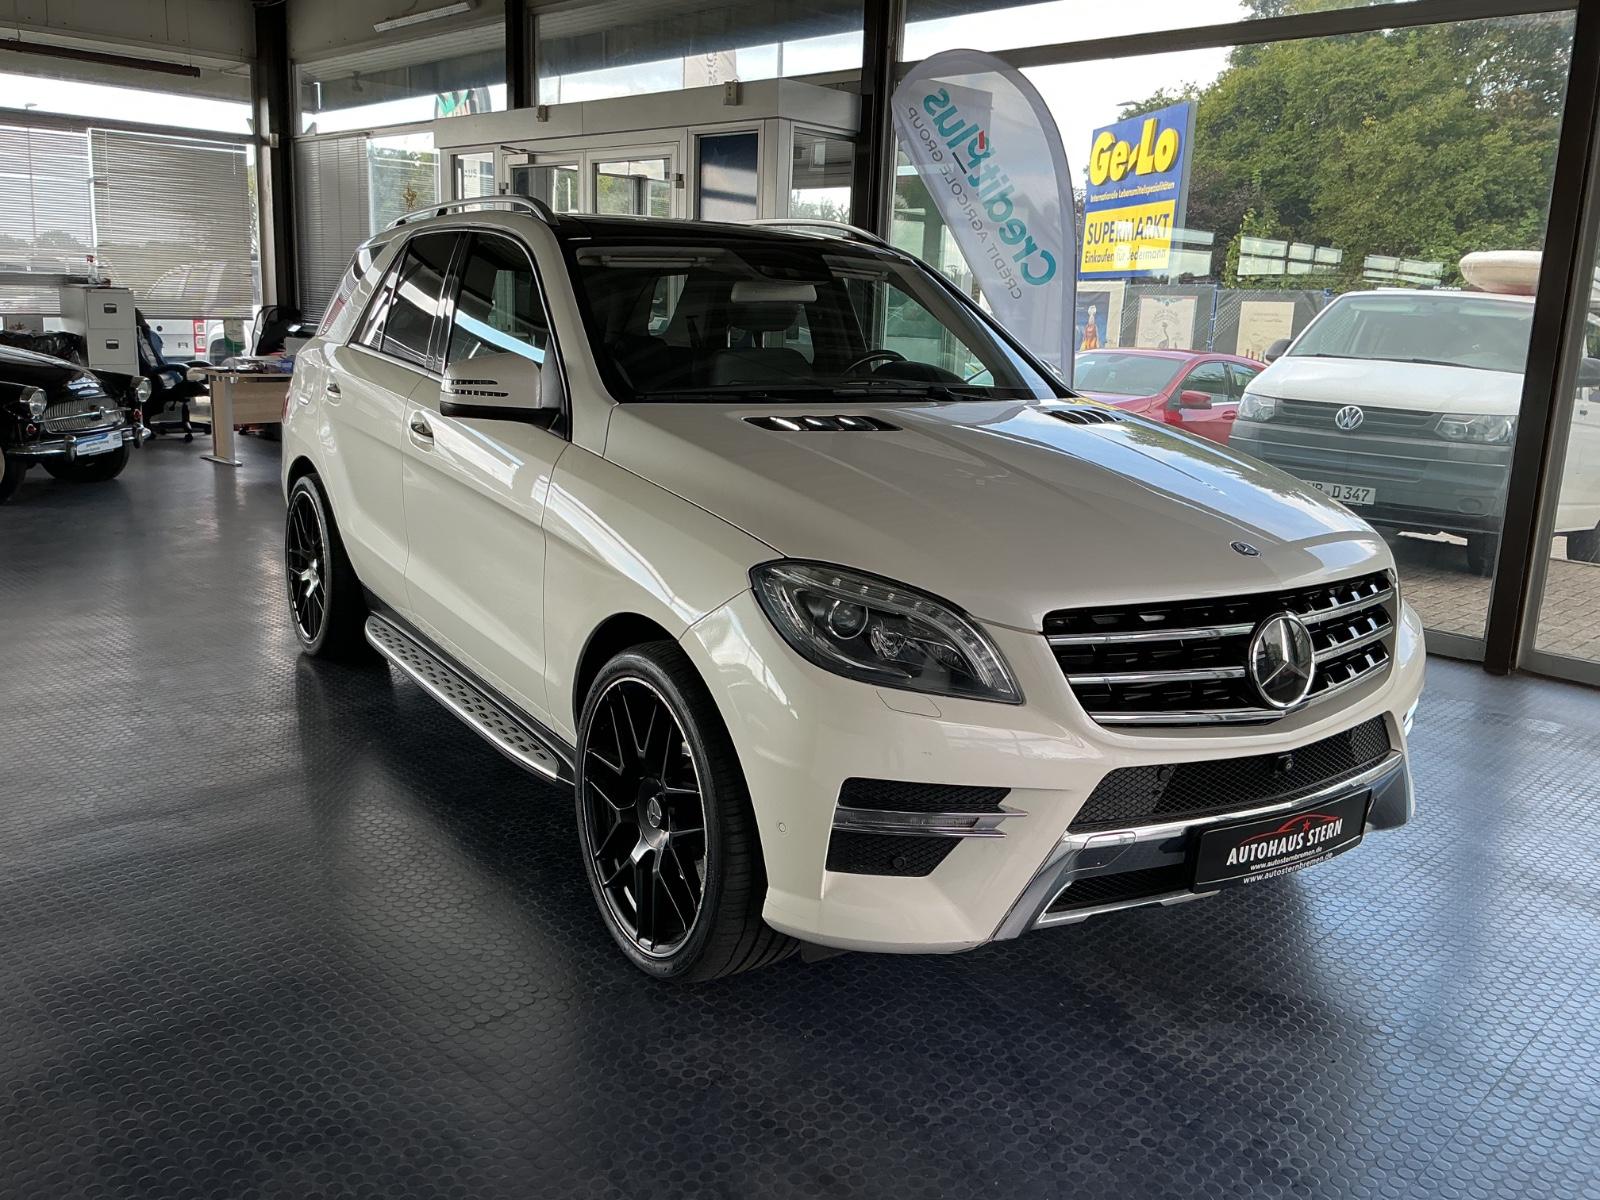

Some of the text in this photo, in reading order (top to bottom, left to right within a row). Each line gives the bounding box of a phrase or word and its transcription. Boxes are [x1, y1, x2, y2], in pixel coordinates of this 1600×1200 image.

[1087, 213, 1170, 246] SUPERMARKT
[1084, 248, 1115, 264] Einkaufen
[1343, 486, 1370, 502] 347
[1226, 818, 1343, 866] AUTOHAUS STERN
[1243, 852, 1334, 884] www.autosternbremen.de
[1250, 846, 1323, 871] www.autosternbremen.de
